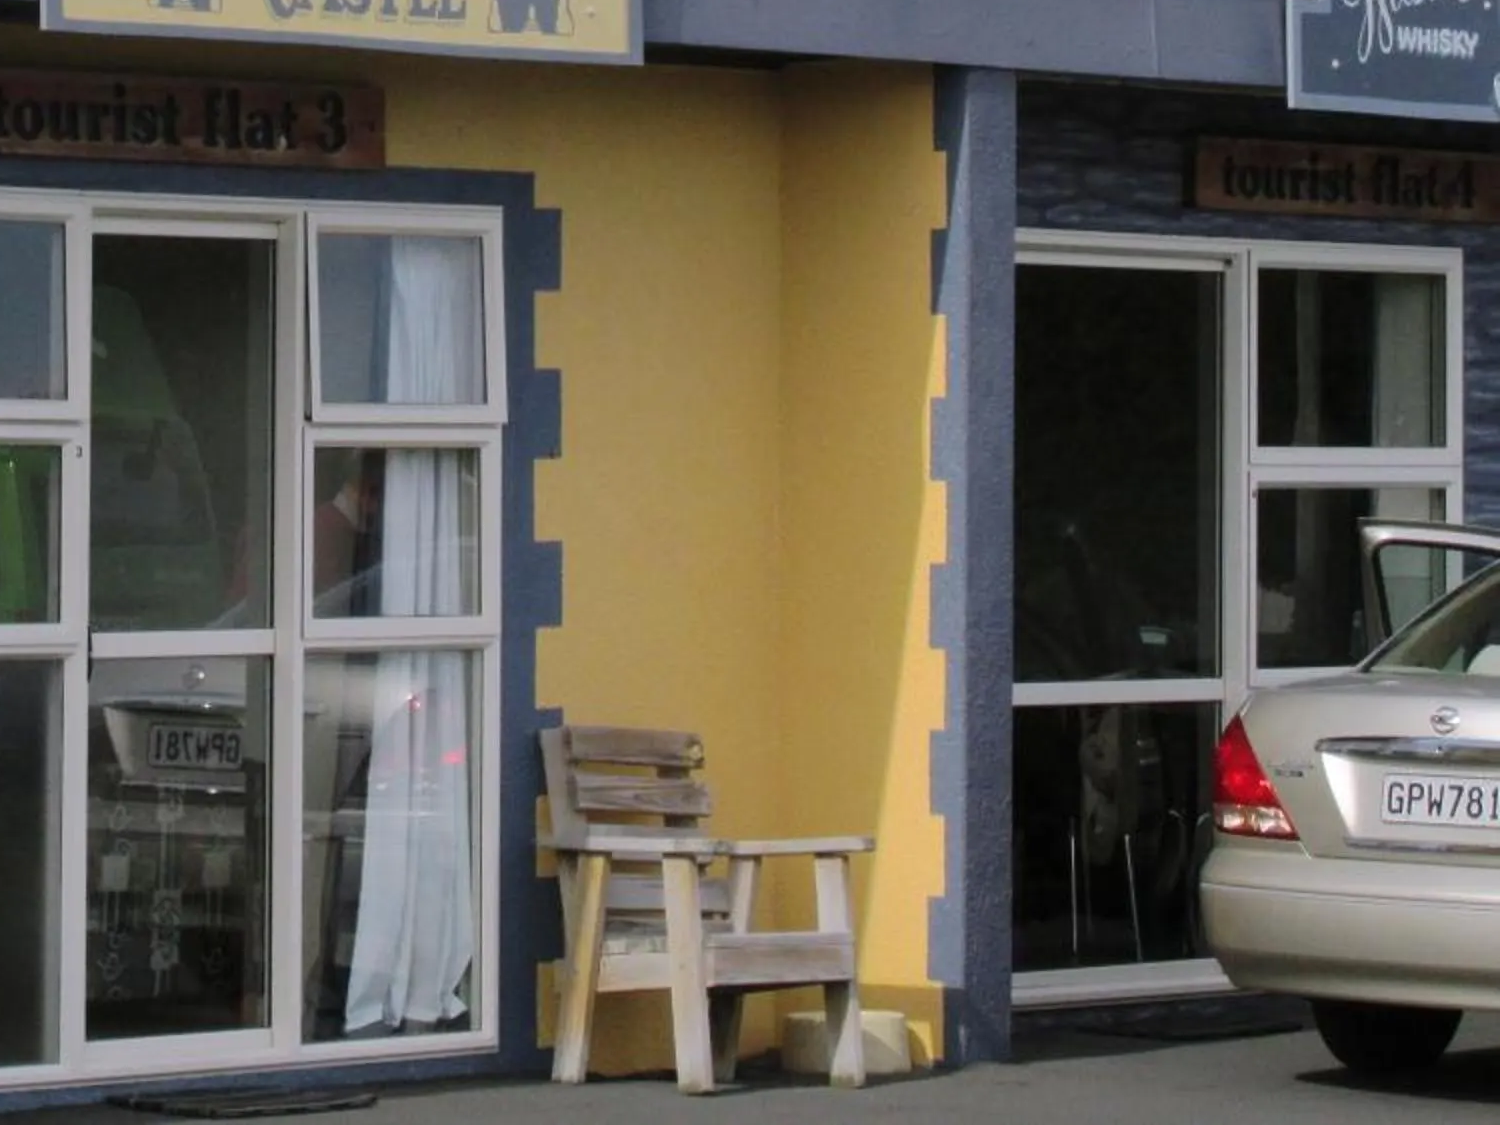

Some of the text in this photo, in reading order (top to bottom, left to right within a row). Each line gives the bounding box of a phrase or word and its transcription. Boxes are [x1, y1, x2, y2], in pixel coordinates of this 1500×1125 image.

[1396, 25, 1480, 60] WHISKY
[201, 86, 299, 152] flat
[315, 88, 349, 155] 3
[1221, 151, 1355, 204] tourist
[1370, 154, 1438, 208] flat
[1386, 781, 1500, 820] GPW781
